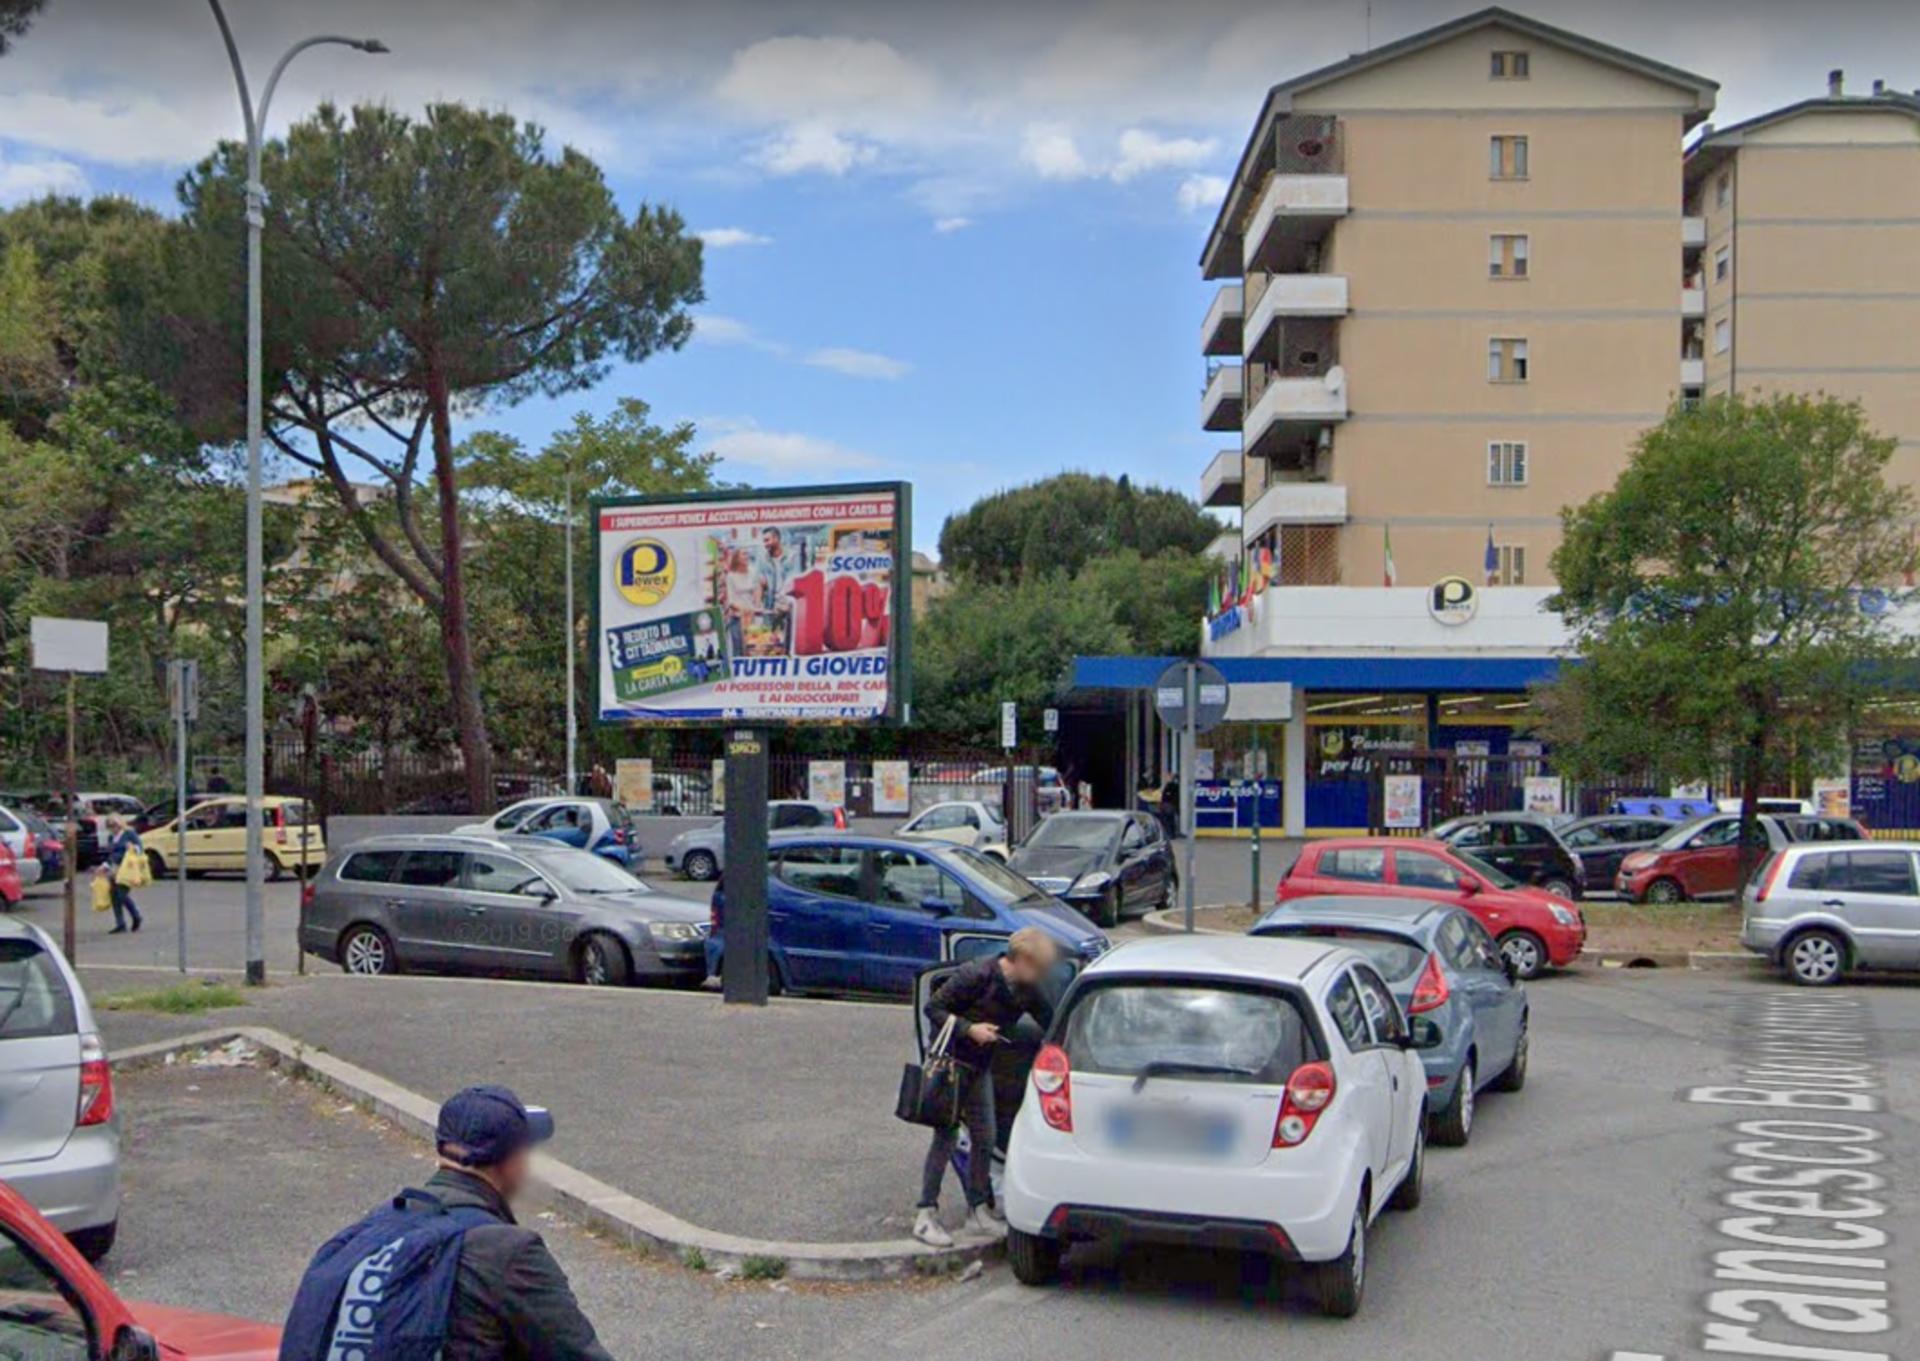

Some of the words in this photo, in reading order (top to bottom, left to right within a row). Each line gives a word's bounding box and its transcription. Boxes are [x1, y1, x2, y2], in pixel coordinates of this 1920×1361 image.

[813, 506, 835, 518] CON
[836, 505, 847, 516] LA
[849, 503, 877, 516] CARTA
[733, 657, 787, 677] TUTTI
[793, 657, 800, 677] I
[715, 682, 727, 693] AI
[730, 681, 795, 693] POSSESSORI
[797, 681, 831, 692] DELLA
[759, 693, 766, 703] E
[769, 693, 781, 703] AI
